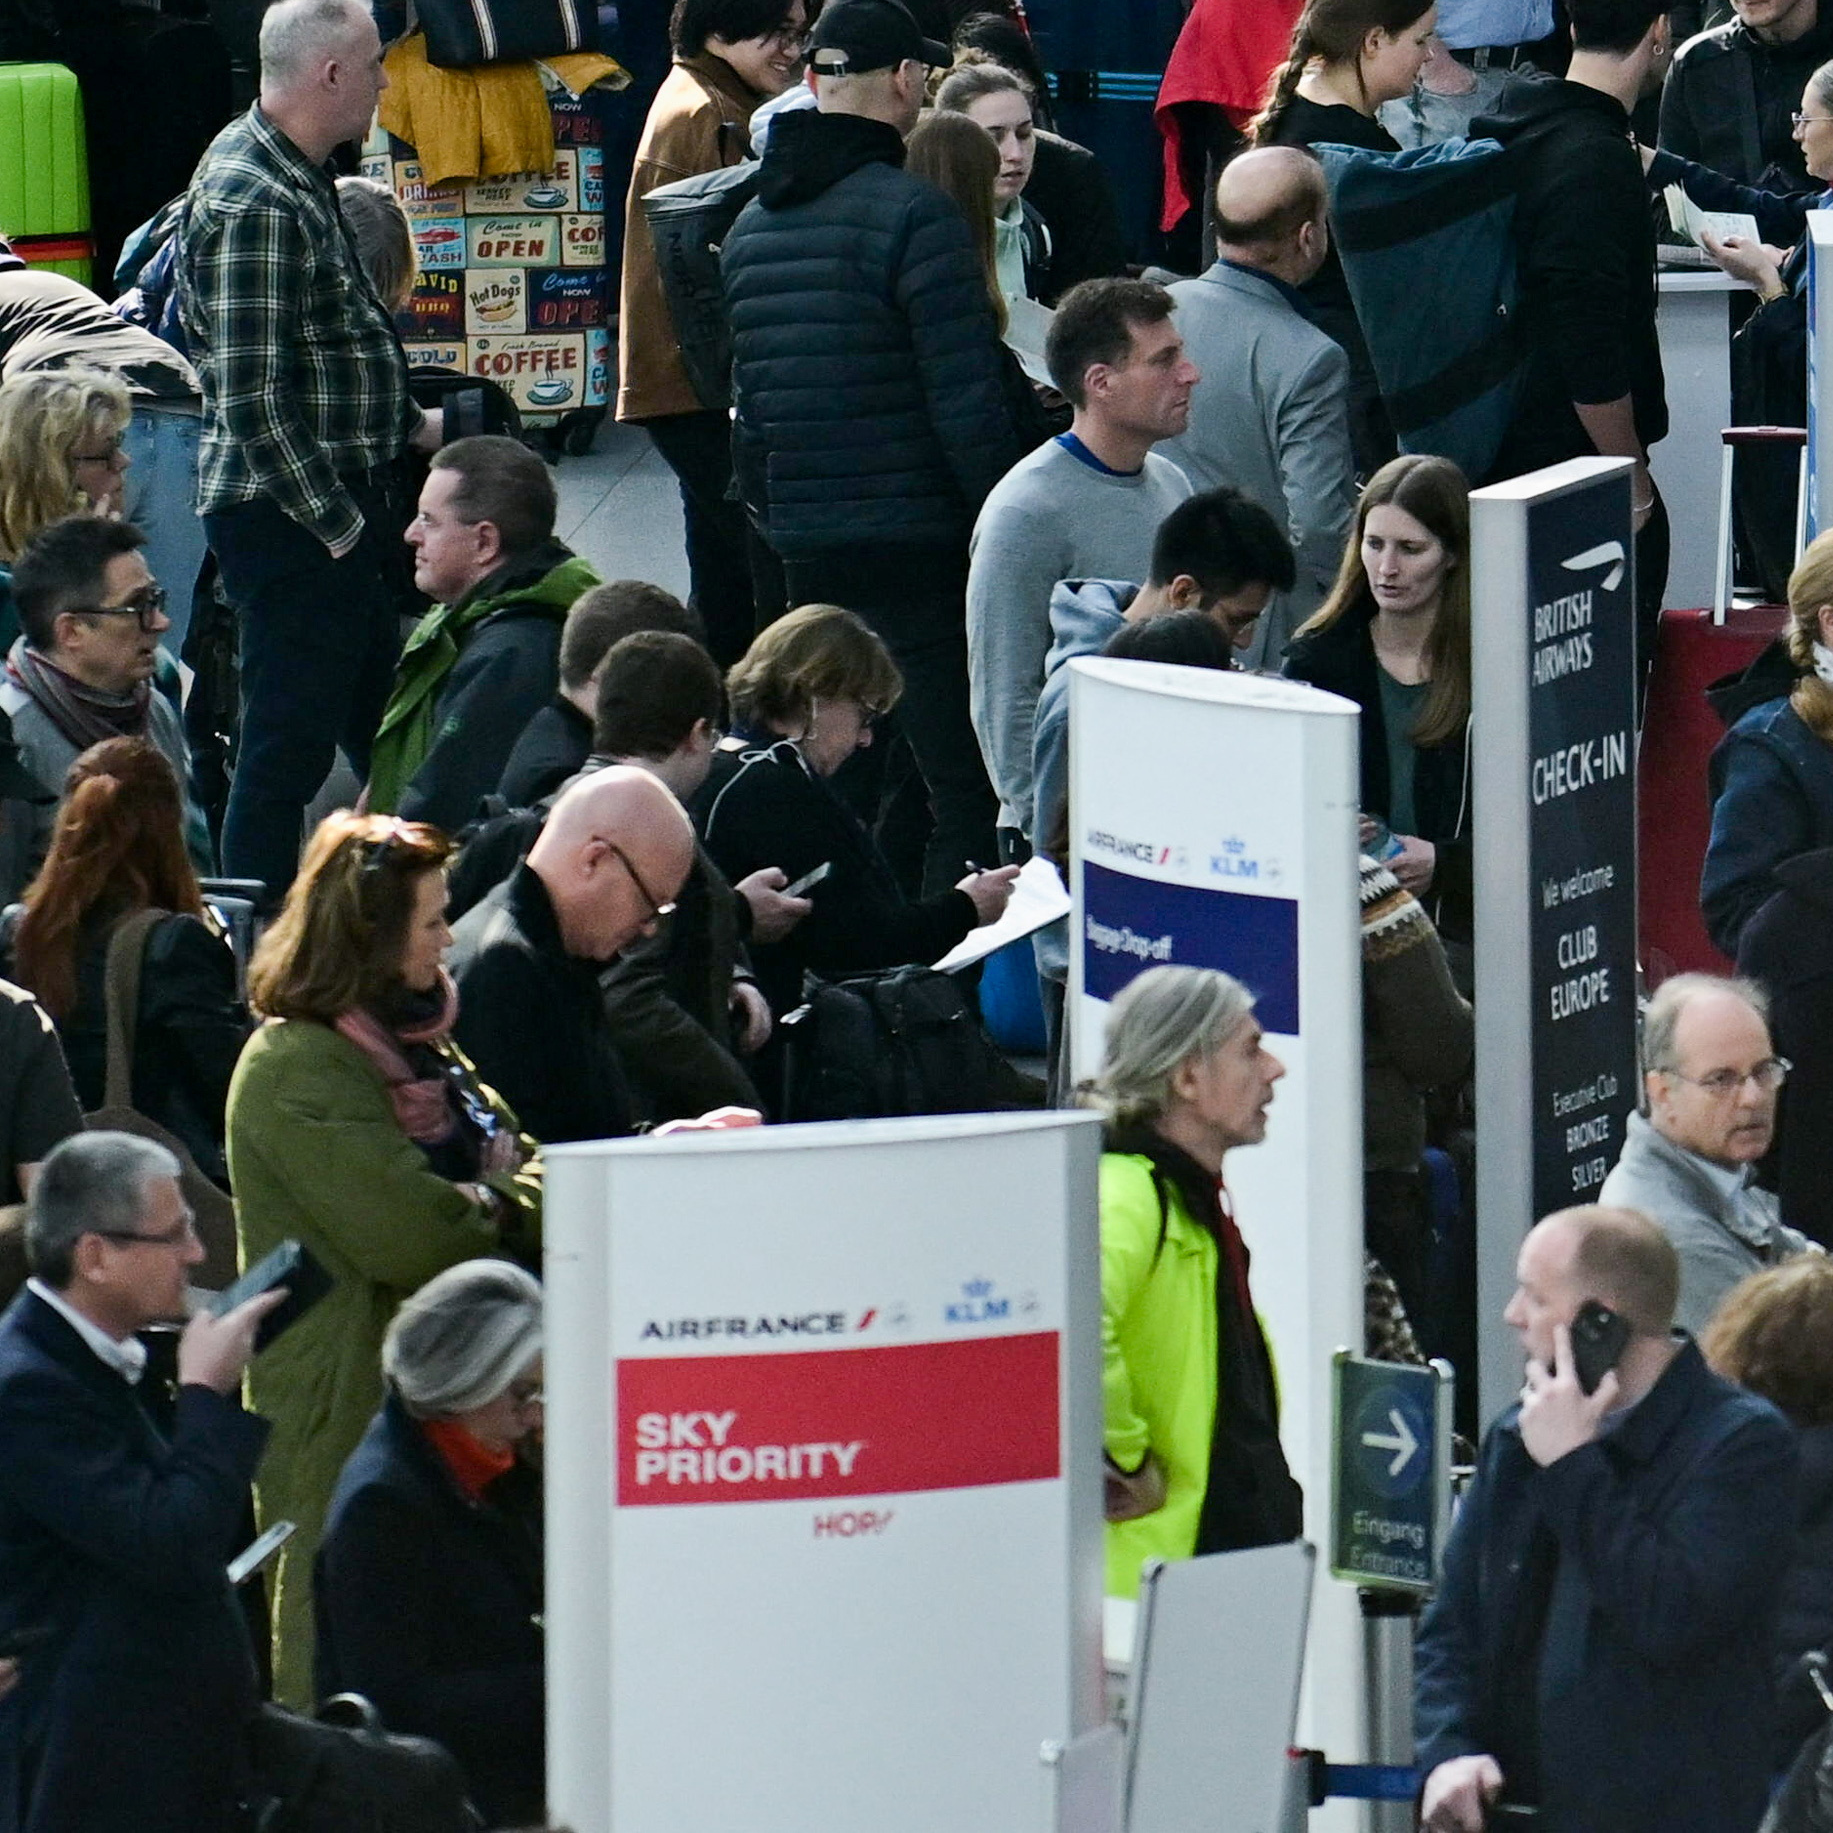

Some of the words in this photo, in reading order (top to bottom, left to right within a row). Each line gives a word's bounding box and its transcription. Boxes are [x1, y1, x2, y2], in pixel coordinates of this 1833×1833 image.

[553, 101, 583, 113] NOW
[482, 220, 523, 235] Come
[527, 219, 543, 230] in
[476, 239, 545, 259] OPEN
[468, 287, 491, 307] Hot
[491, 283, 522, 303] Dogs
[542, 272, 588, 292] Come
[562, 288, 592, 297] NOW
[475, 347, 578, 377] COFFEE
[1534, 589, 1593, 643] BRITISH
[1533, 632, 1593, 685] AIRWAYS
[1532, 730, 1626, 806] CHECK-IN
[1211, 856, 1259, 878] KLM
[1561, 865, 1614, 904] welcome
[1558, 925, 1599, 970] CLUB
[1551, 968, 1610, 1021] EUROPE
[1552, 1086, 1597, 1118] Executive
[1596, 1072, 1619, 1101] Club
[1565, 1114, 1610, 1153] BRONZE
[1571, 1156, 1608, 1192] SILVER
[640, 1312, 846, 1341] AIRFRANCE
[944, 1298, 1010, 1323] KLM
[635, 1411, 740, 1448] SKY
[635, 1442, 864, 1486] PRIORITY
[1352, 1509, 1426, 1550] Eingang
